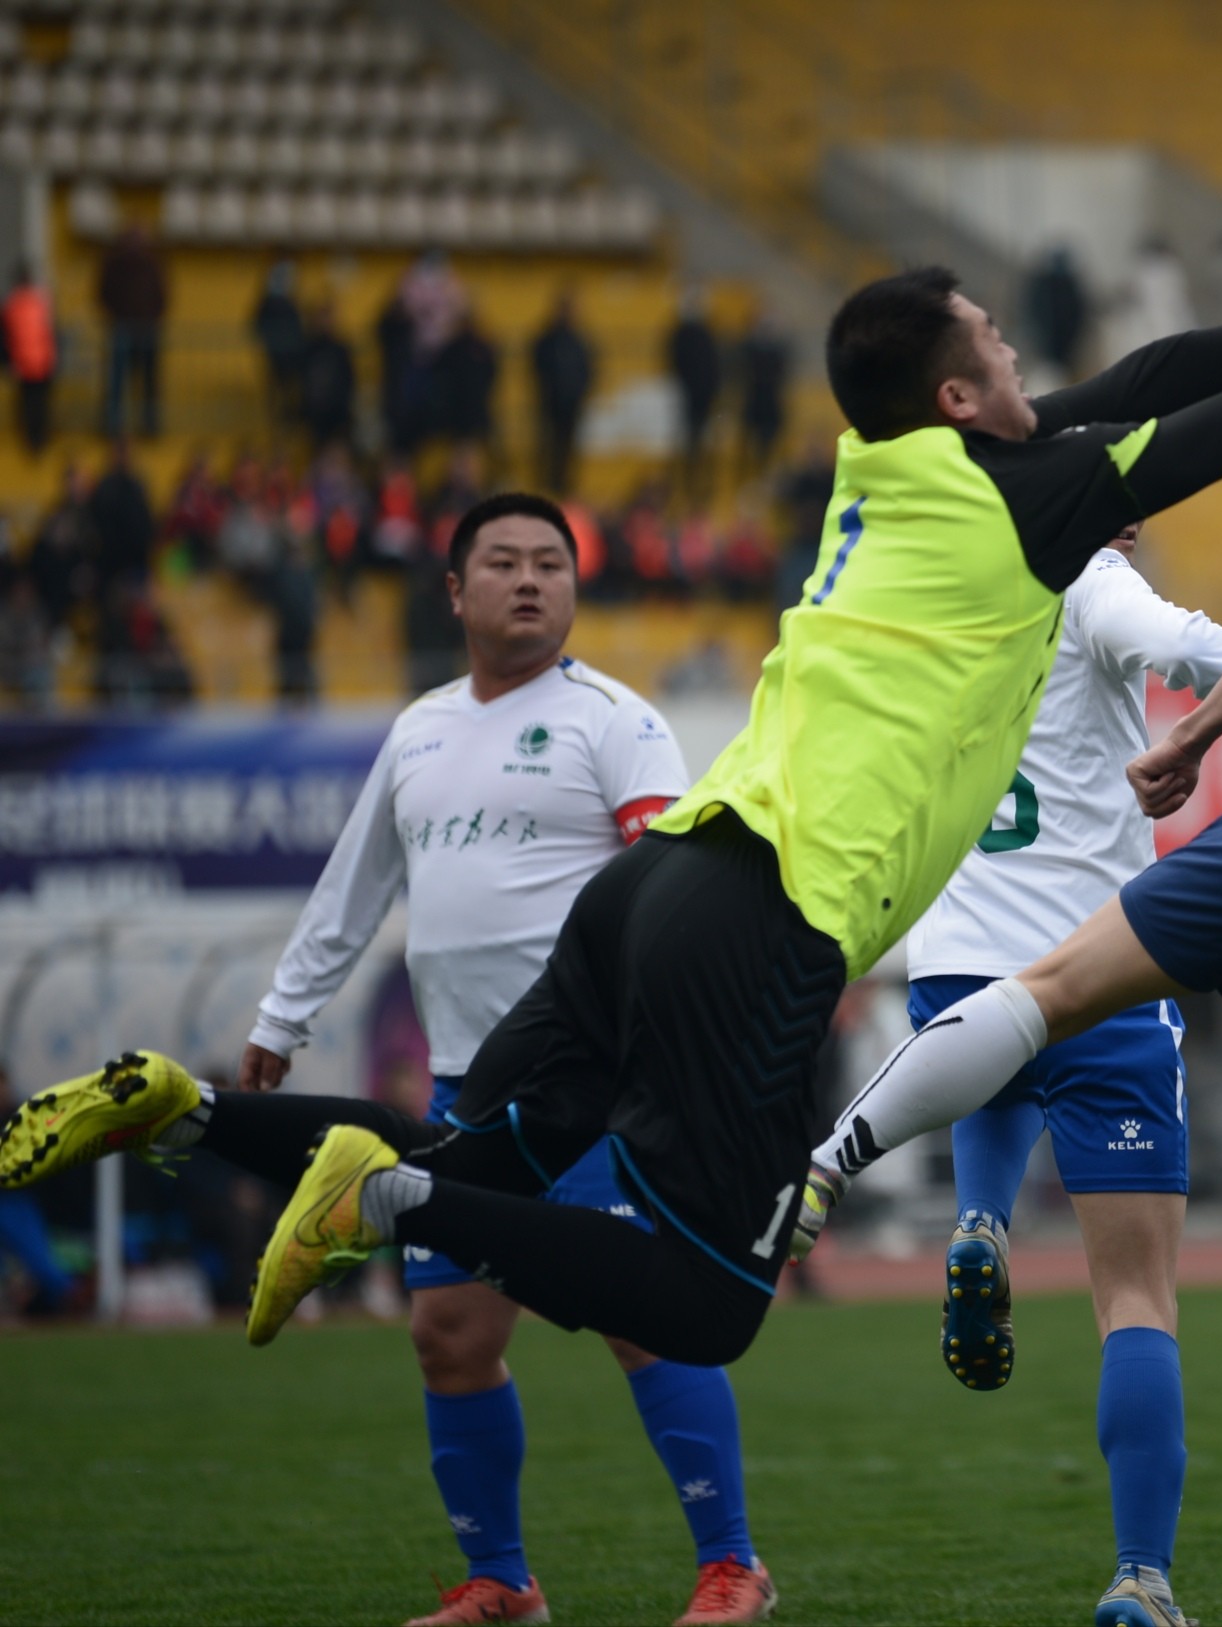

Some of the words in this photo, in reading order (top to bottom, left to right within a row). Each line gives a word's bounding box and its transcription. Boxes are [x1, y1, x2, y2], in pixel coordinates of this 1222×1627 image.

[811, 496, 867, 605] 1
[1107, 1140, 1155, 1150] KELME
[751, 1183, 797, 1260] 1
